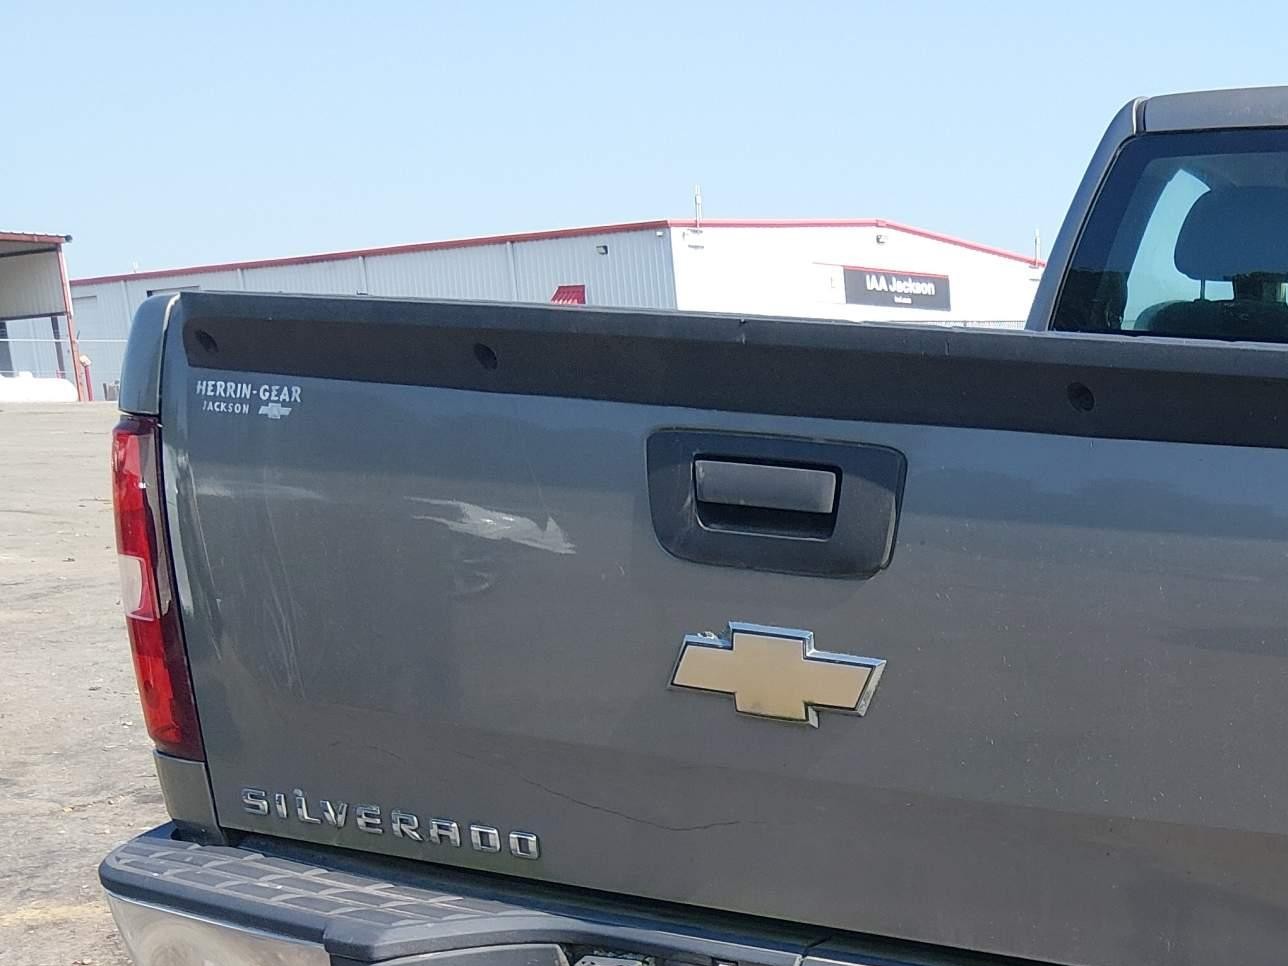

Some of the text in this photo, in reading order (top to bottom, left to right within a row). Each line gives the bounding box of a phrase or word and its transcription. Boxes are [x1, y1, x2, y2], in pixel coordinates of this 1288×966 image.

[865, 274, 936, 296] IAA Jackson
[196, 380, 302, 403] HERRIN-GEAR
[202, 400, 250, 414] JACKSON
[241, 787, 541, 860] SILVERADO
